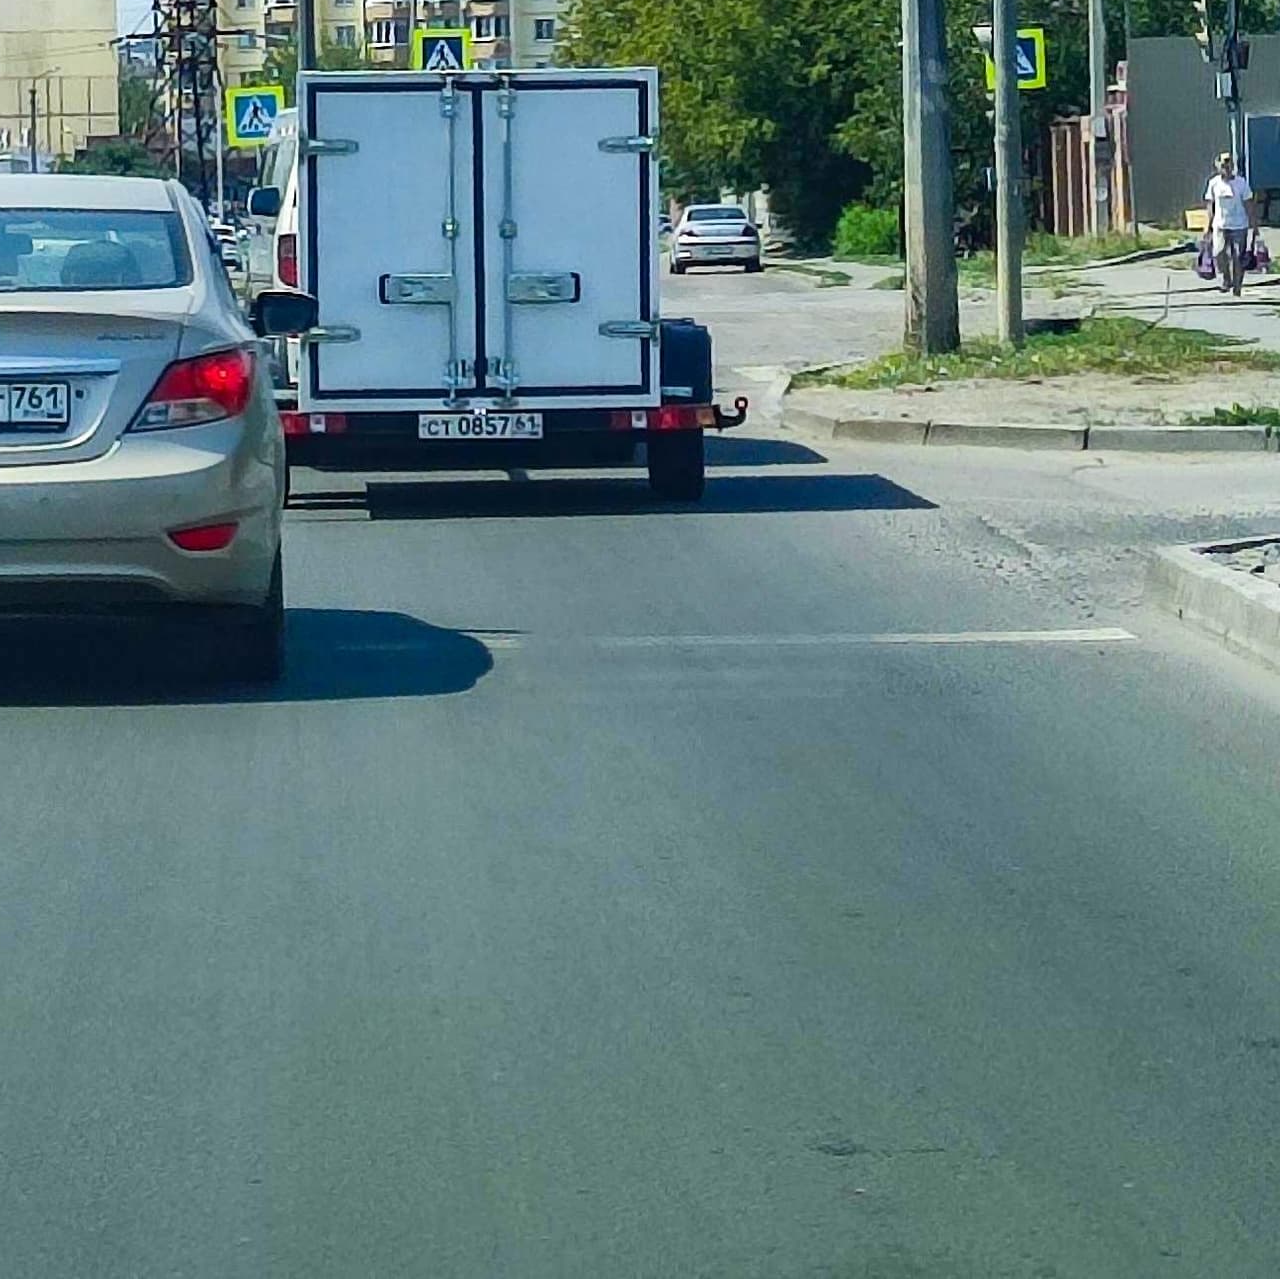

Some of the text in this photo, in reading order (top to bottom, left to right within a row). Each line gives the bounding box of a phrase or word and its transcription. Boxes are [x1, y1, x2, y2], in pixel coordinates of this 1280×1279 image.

[12, 386, 60, 410] 761
[457, 416, 511, 436] 0857
[514, 415, 538, 431] 61
